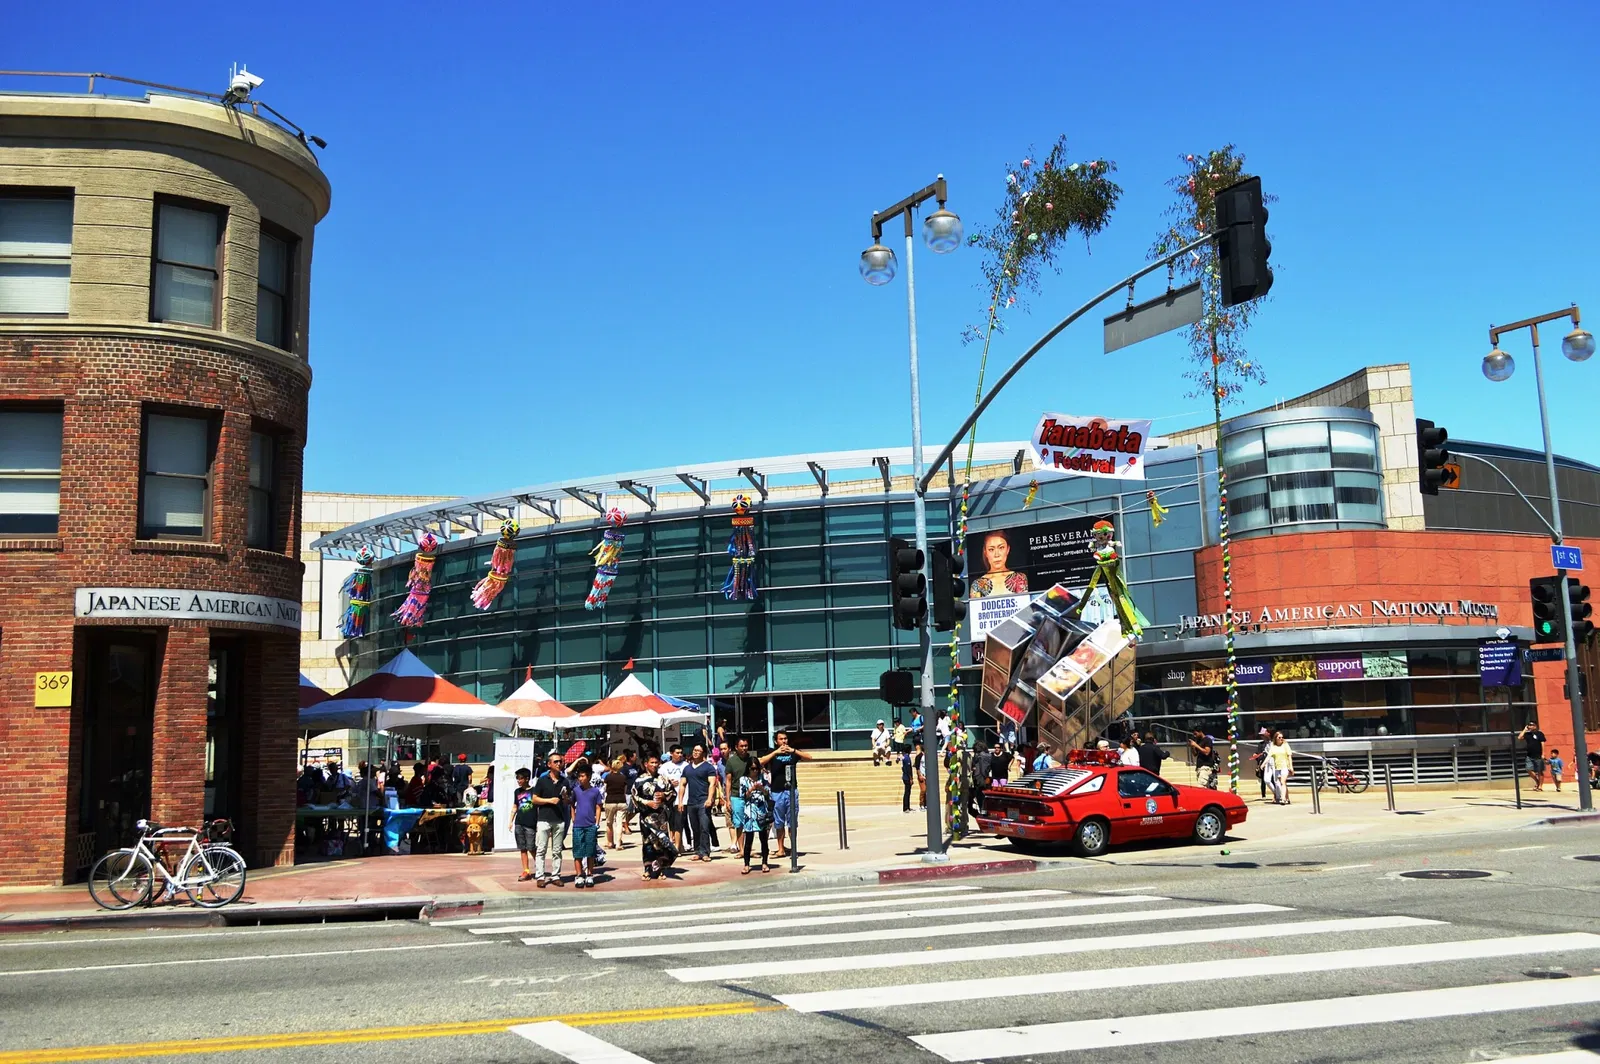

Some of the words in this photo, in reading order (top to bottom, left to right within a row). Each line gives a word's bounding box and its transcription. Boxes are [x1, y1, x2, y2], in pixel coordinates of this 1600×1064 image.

[1039, 419, 1142, 454] Tanabata
[1053, 451, 1115, 474] Festival
[1556, 550, 1566, 564] 1st
[1569, 552, 1578, 564] St
[84, 592, 181, 615] JAPANESE
[187, 594, 273, 617] AMERICAN
[981, 598, 1018, 611] DODGERS:
[1259, 602, 1363, 622] AMERICAN
[1371, 600, 1457, 616] NATIONAL
[1458, 599, 1498, 617] MUSEU
[978, 608, 1021, 620] BROTHERHO
[979, 621, 987, 629] OF
[1235, 665, 1264, 675] share
[1318, 659, 1362, 673] support
[38, 674, 69, 690] 369
[1167, 669, 1185, 681] shop
